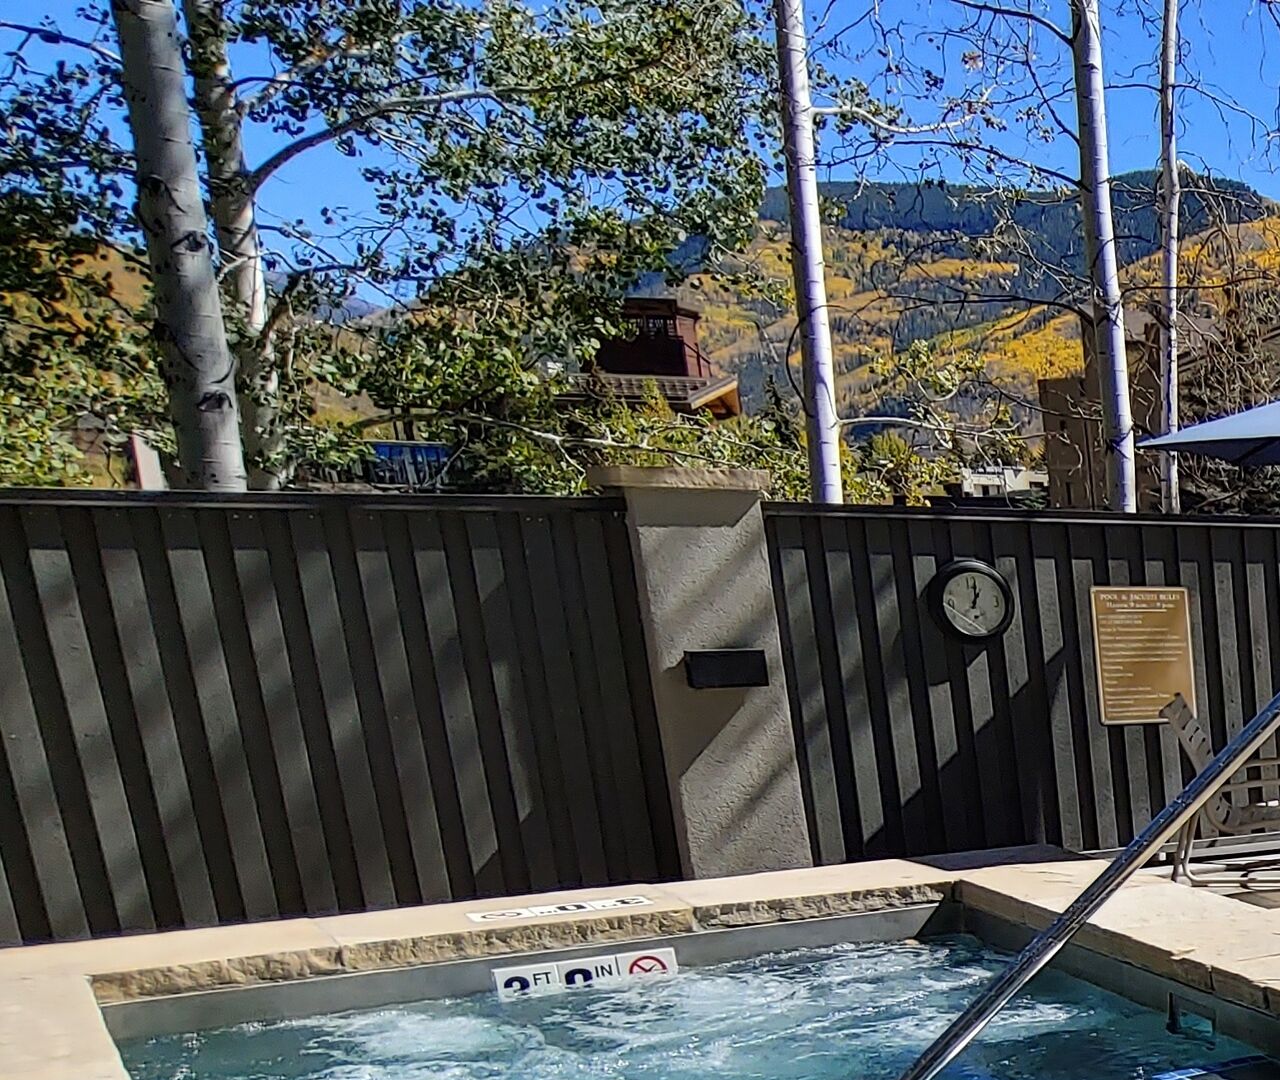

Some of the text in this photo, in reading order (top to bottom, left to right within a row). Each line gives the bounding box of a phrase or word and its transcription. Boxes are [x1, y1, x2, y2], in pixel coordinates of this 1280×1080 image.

[1100, 593, 1118, 601] POOL
[533, 971, 551, 986] FT
[594, 963, 613, 978] IN
